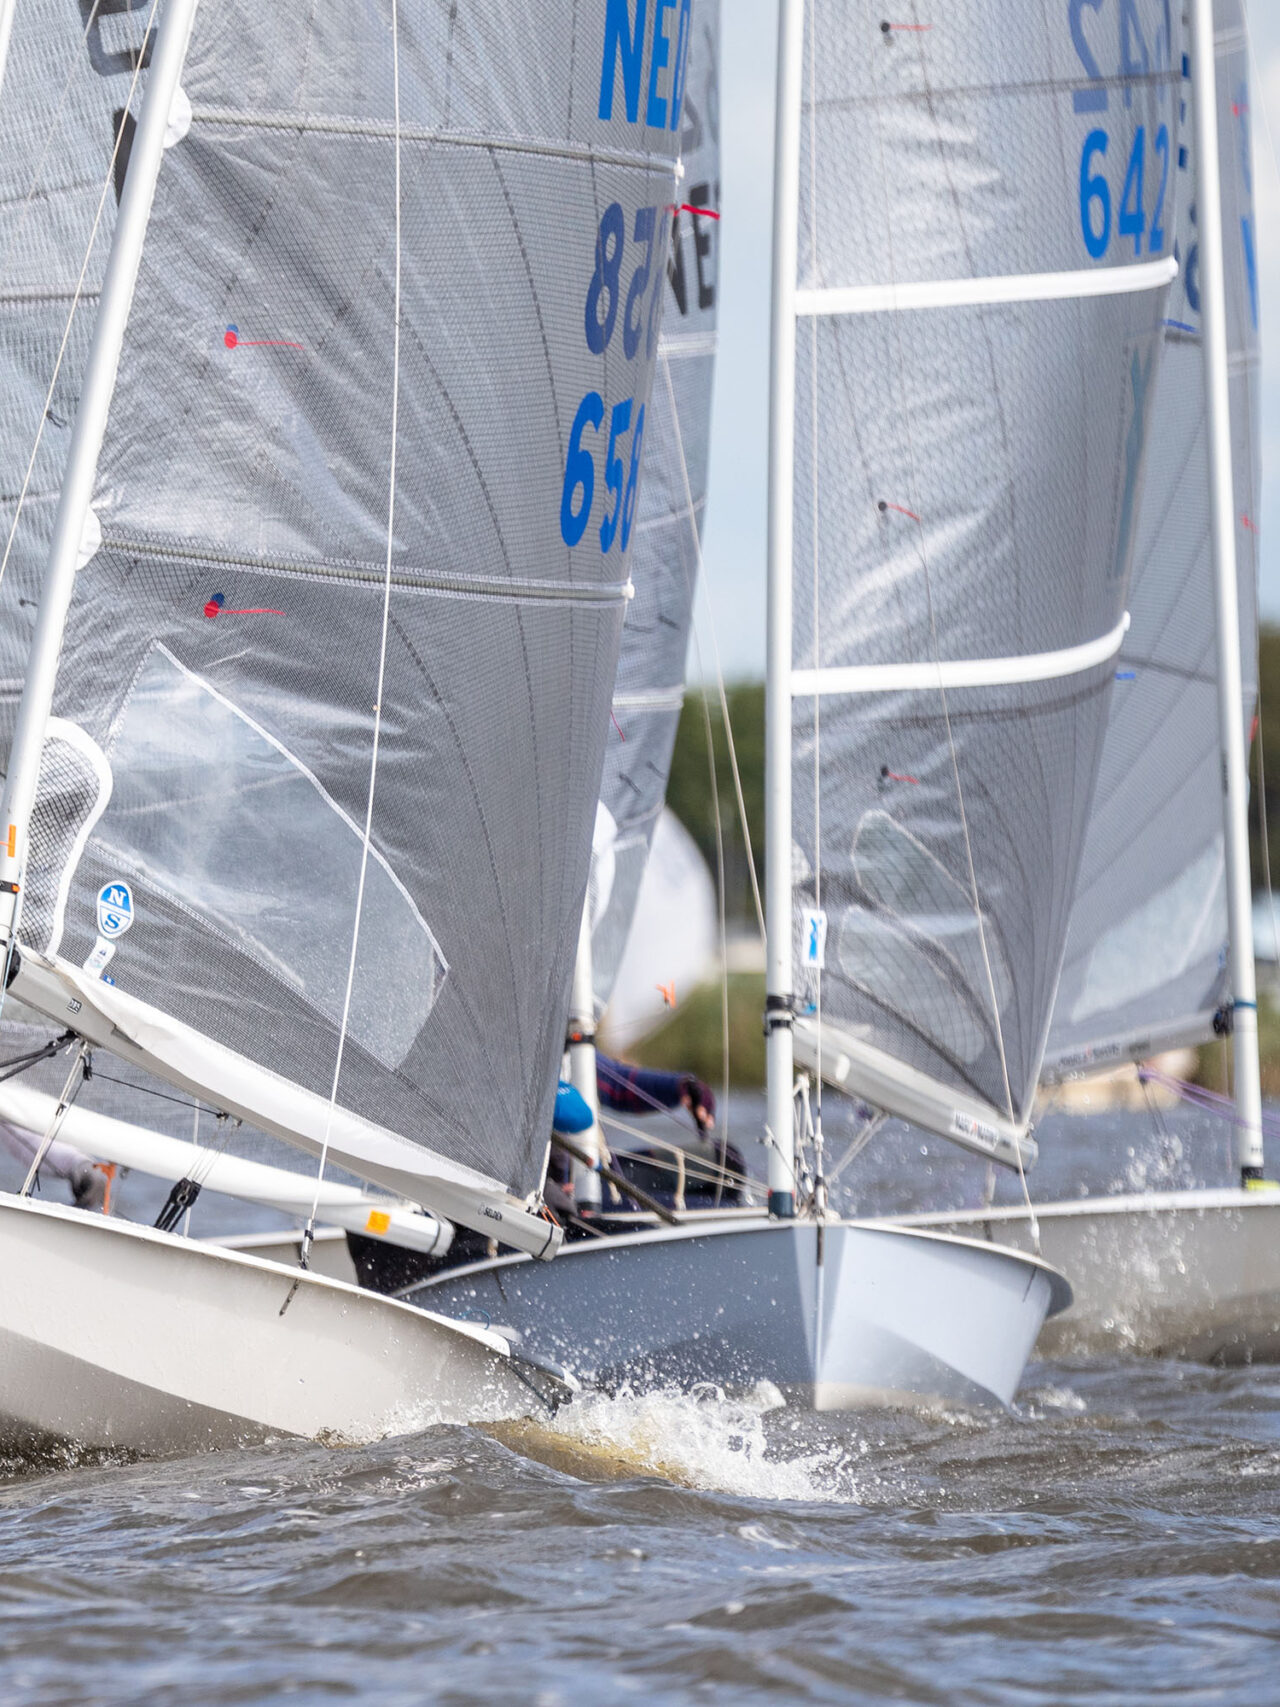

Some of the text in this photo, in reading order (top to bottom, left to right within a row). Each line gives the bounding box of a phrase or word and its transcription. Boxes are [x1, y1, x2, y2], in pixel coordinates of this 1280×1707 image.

[598, 0, 691, 132] NED
[1080, 123, 1170, 261] 642
[560, 391, 646, 554] 658
[104, 913, 121, 929] S
[107, 887, 127, 907] N
